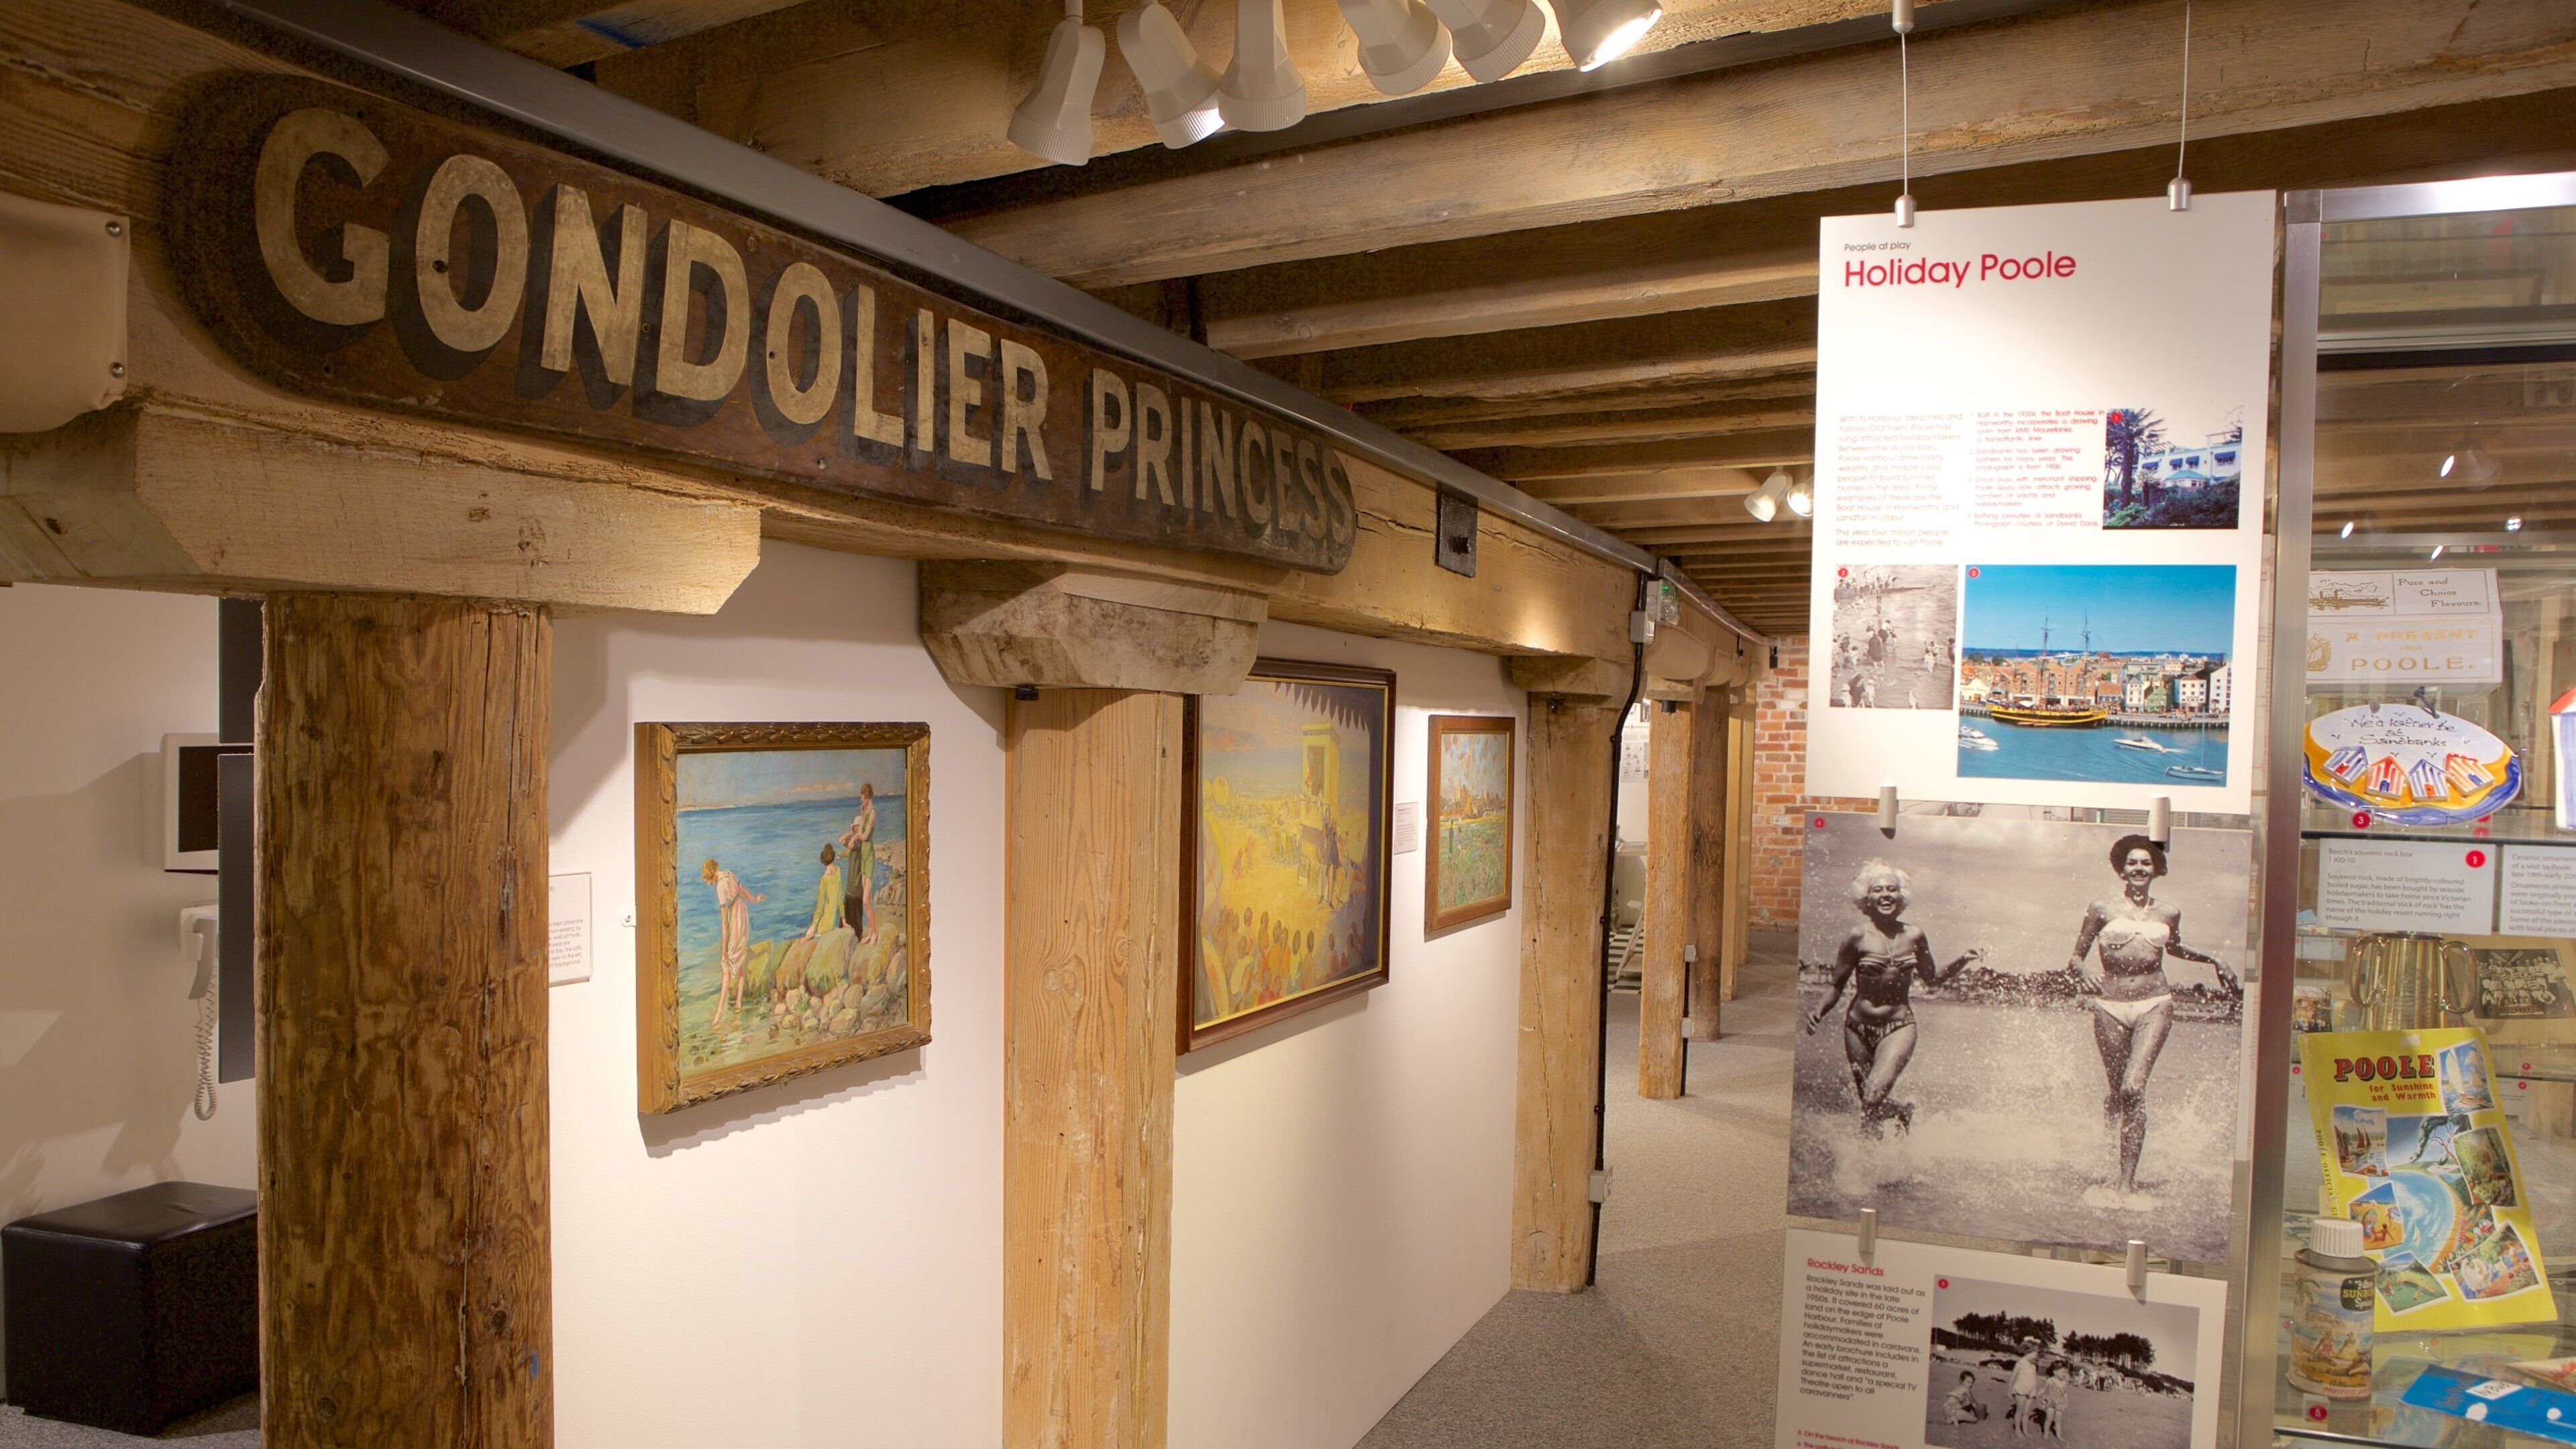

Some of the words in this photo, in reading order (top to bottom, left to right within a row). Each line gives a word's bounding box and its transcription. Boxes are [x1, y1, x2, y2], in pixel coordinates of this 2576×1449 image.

[1845, 243, 1876, 252] People
[1878, 242, 1888, 250] at
[1890, 241, 1911, 251] play
[1845, 258, 1971, 288] Holiday
[1981, 251, 2076, 280] Poole
[255, 108, 1053, 481] GONDOLIER
[1091, 368, 1354, 544] PRINCESS
[2376, 629, 2477, 641] PRESENT
[2351, 657, 2474, 671] POOLE.
[2390, 718, 2434, 729] rather
[2436, 720, 2458, 732] be
[2385, 729, 2405, 737] at
[2359, 734, 2447, 747] Sandbanks
[2358, 816, 2364, 824] 3
[2405, 877, 2464, 885] brightly-coloured
[2326, 890, 2375, 898] holidaymakers
[2402, 885, 2428, 893] bought
[2326, 914, 2353, 922] through
[2334, 1055, 2434, 1082] POOLE
[2369, 1085, 2384, 1093] for
[2392, 1083, 2434, 1091] Sunshine
[2372, 1093, 2389, 1102] and
[2396, 1091, 2436, 1101] Warmth
[1807, 1258, 1849, 1273] Rockley
[1851, 1264, 1884, 1276] Sands
[1807, 1275, 1837, 1286] Rockley
[1839, 1279, 1864, 1289] Sands
[1883, 1285, 1898, 1293] laid
[1813, 1285, 1843, 1296] holiday
[1870, 1293, 1882, 1301] the
[1884, 1294, 1900, 1303] late
[1805, 1303, 1823, 1311] land
[1837, 1307, 1850, 1316] the
[1852, 1310, 1874, 1320] edge
[1886, 1313, 1909, 1323] Poole
[1839, 1299, 1872, 1309] covered
[1886, 1305, 1909, 1313] acres
[1804, 1322, 1862, 1336] holidaymakers
[1840, 1317, 1872, 1328] Families
[1803, 1332, 1870, 1346] accommodated
[1802, 1349, 1815, 1357] the
[1817, 1351, 1827, 1359] list
[1837, 1355, 1880, 1366] attractions
[1815, 1343, 1835, 1352] early
[1837, 1345, 1873, 1356] brochure
[1875, 1350, 1909, 1361] includes
[1801, 1368, 1828, 1378] dance
[1829, 1372, 1844, 1381] hall
[1876, 1378, 1905, 1389] special
[1801, 1377, 1830, 1388] Theatre
[1856, 1439, 1880, 1448] Rockley
